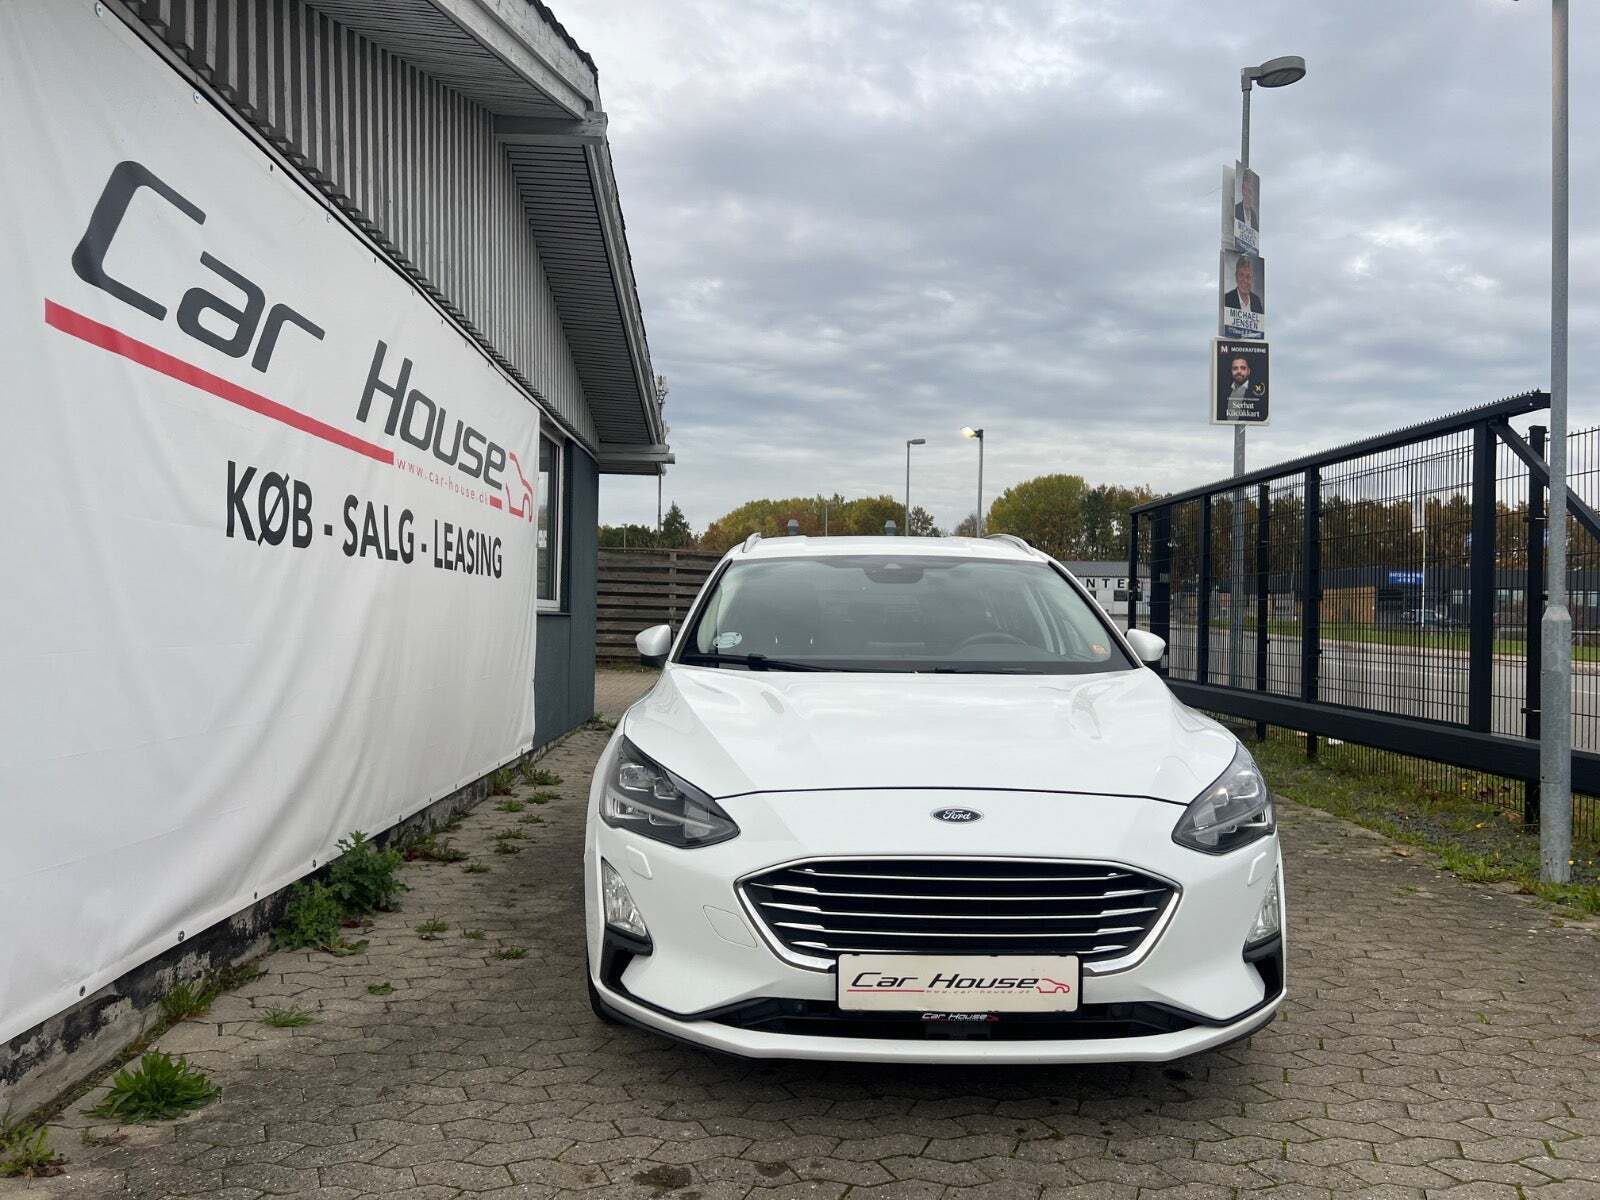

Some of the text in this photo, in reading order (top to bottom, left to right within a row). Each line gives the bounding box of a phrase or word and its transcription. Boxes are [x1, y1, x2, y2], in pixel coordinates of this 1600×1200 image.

[1230, 308, 1260, 322] MICHAEL
[72, 160, 506, 490] Car House
[1231, 318, 1258, 330] JENSEN
[226, 460, 313, 549] KØB
[342, 494, 415, 563] SALG
[433, 519, 503, 579] LEASING
[942, 809, 972, 820] Ford
[851, 971, 1040, 989] Car House
[921, 1012, 988, 1021] Car House
